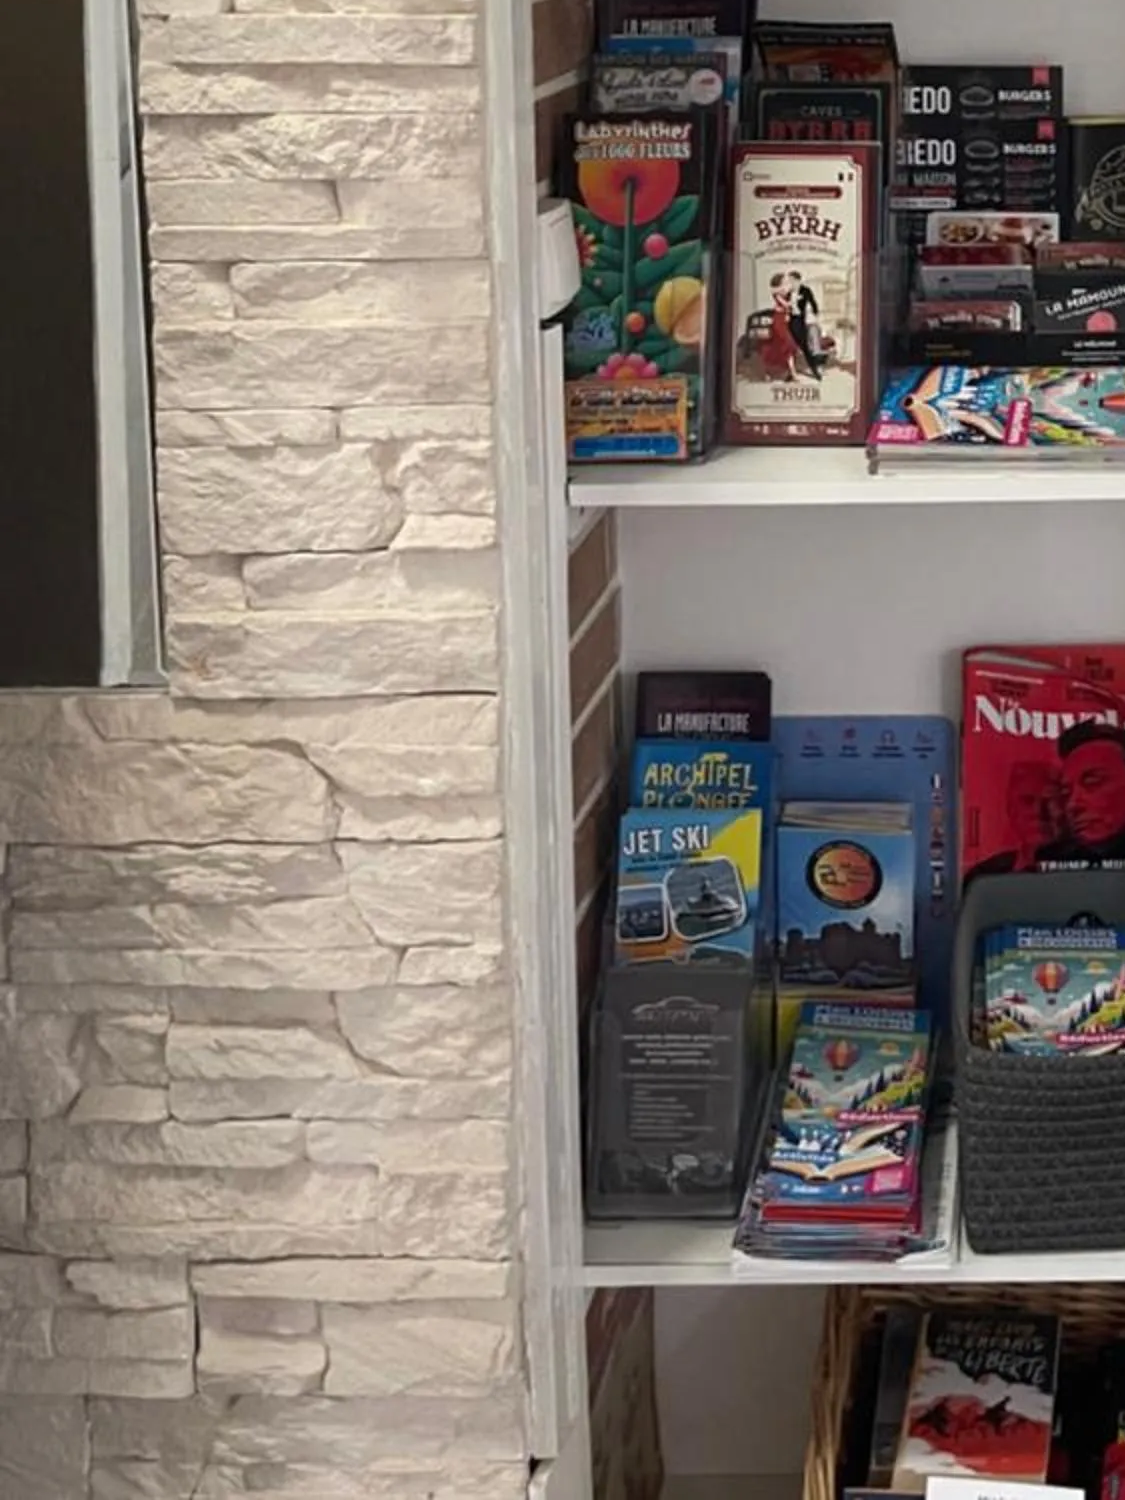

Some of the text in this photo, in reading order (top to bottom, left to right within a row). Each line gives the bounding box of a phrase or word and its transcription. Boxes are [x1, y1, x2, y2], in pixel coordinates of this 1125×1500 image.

[773, 204, 819, 216] CAVES
[754, 216, 842, 242] BYRRH
[1045, 302, 1063, 316] LA
[772, 387, 821, 402] THUIR
[657, 712, 751, 734] LA MANUFACTURE
[643, 761, 760, 792] ARCHIPEL
[623, 825, 710, 856] JET SKI
[1039, 859, 1090, 872] TRUMP
